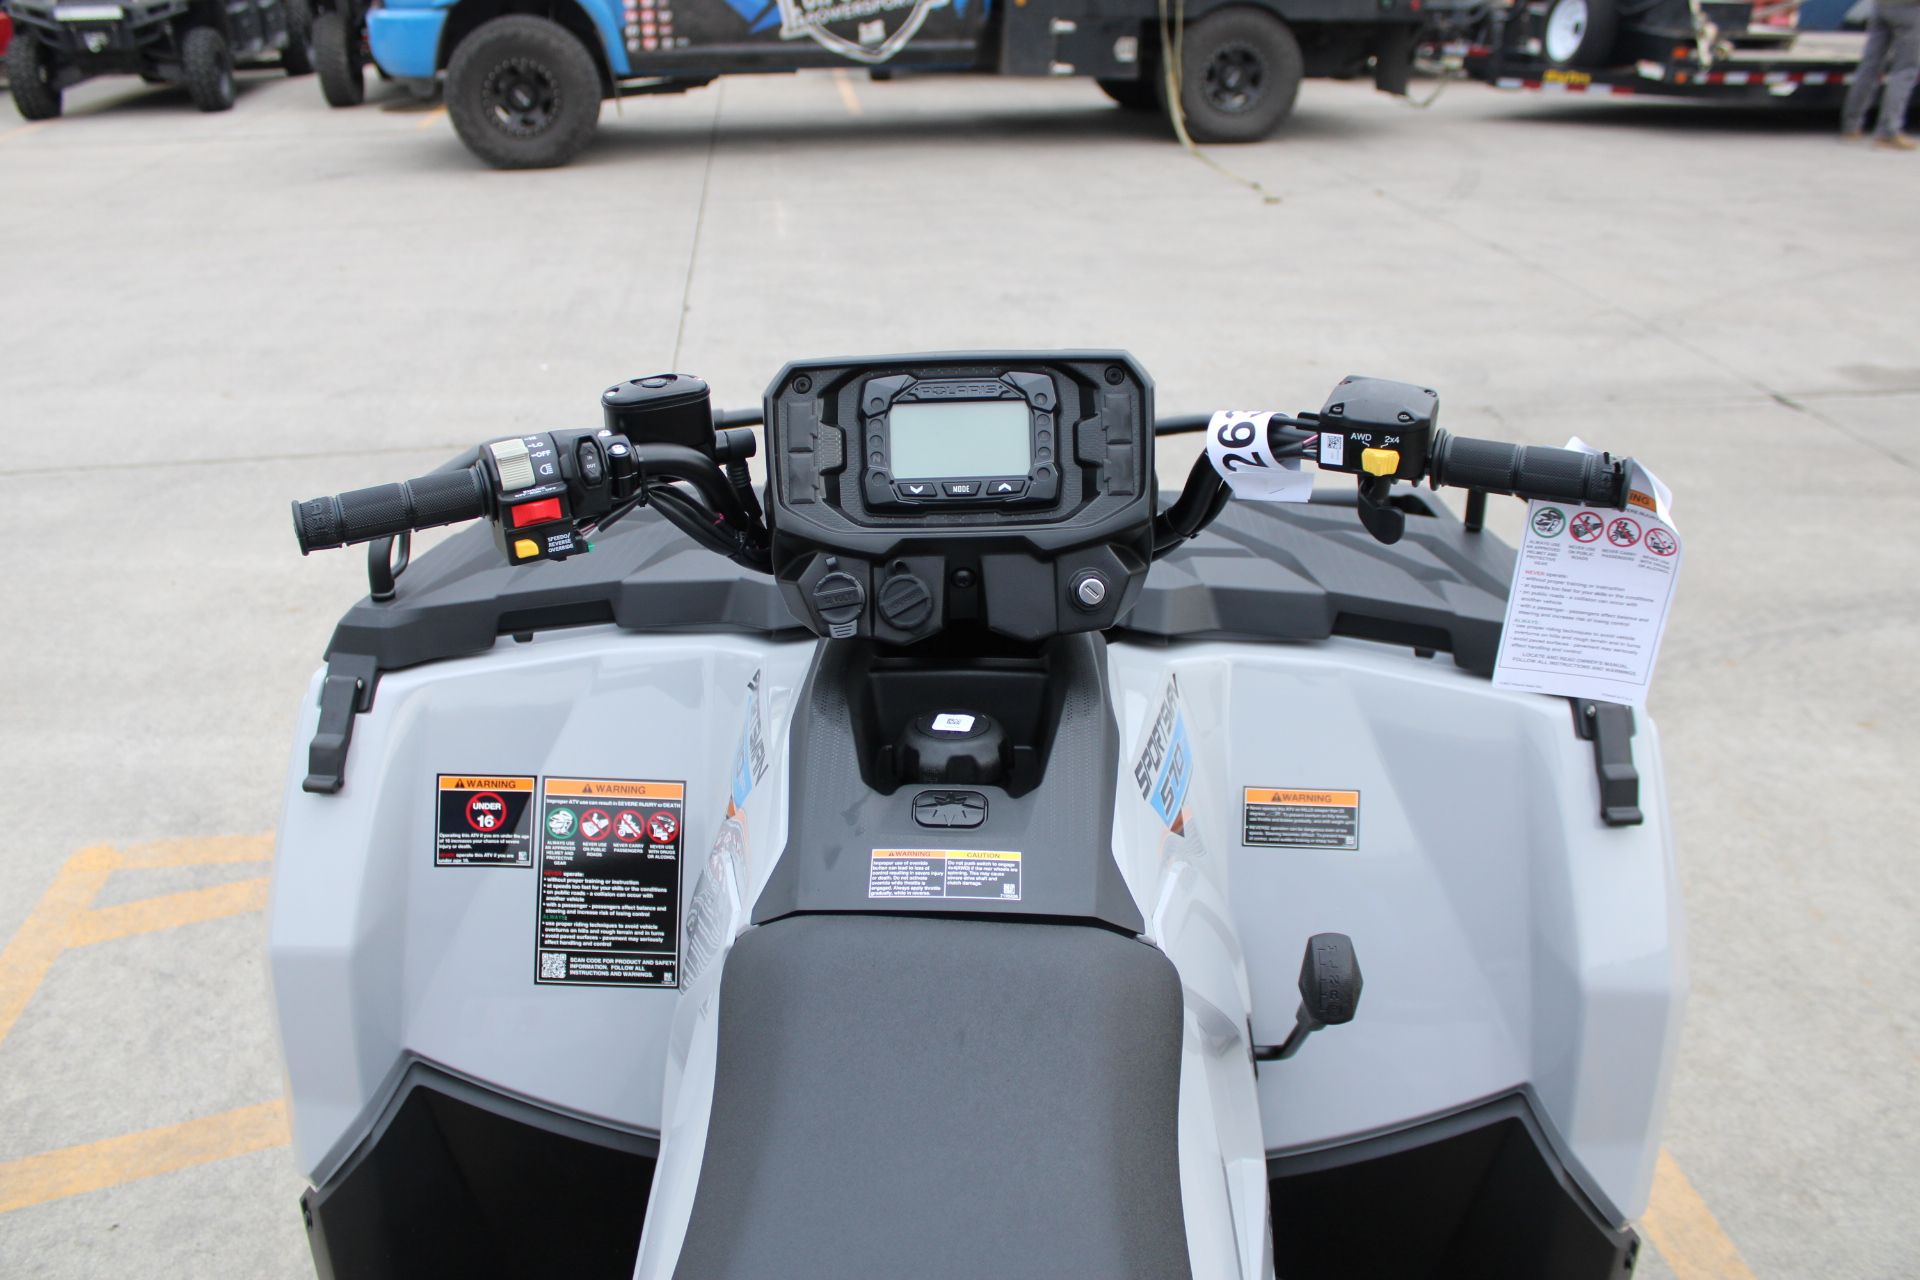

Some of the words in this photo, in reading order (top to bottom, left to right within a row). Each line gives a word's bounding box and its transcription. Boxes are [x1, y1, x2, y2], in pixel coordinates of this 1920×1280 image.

[920, 384, 997, 395] POLARIS
[1217, 410, 1270, 472] 26
[1350, 432, 1372, 441] AWD
[953, 485, 970, 493] MODE
[548, 533, 570, 542] SPEEDO/
[548, 538, 571, 547] REVERSE
[548, 544, 573, 553] OVERRIDE
[1160, 742, 1184, 816] 570
[466, 780, 516, 788] WARNING
[596, 784, 646, 794] WARNING
[1282, 794, 1332, 802] WARNING
[477, 815, 494, 827] 16
